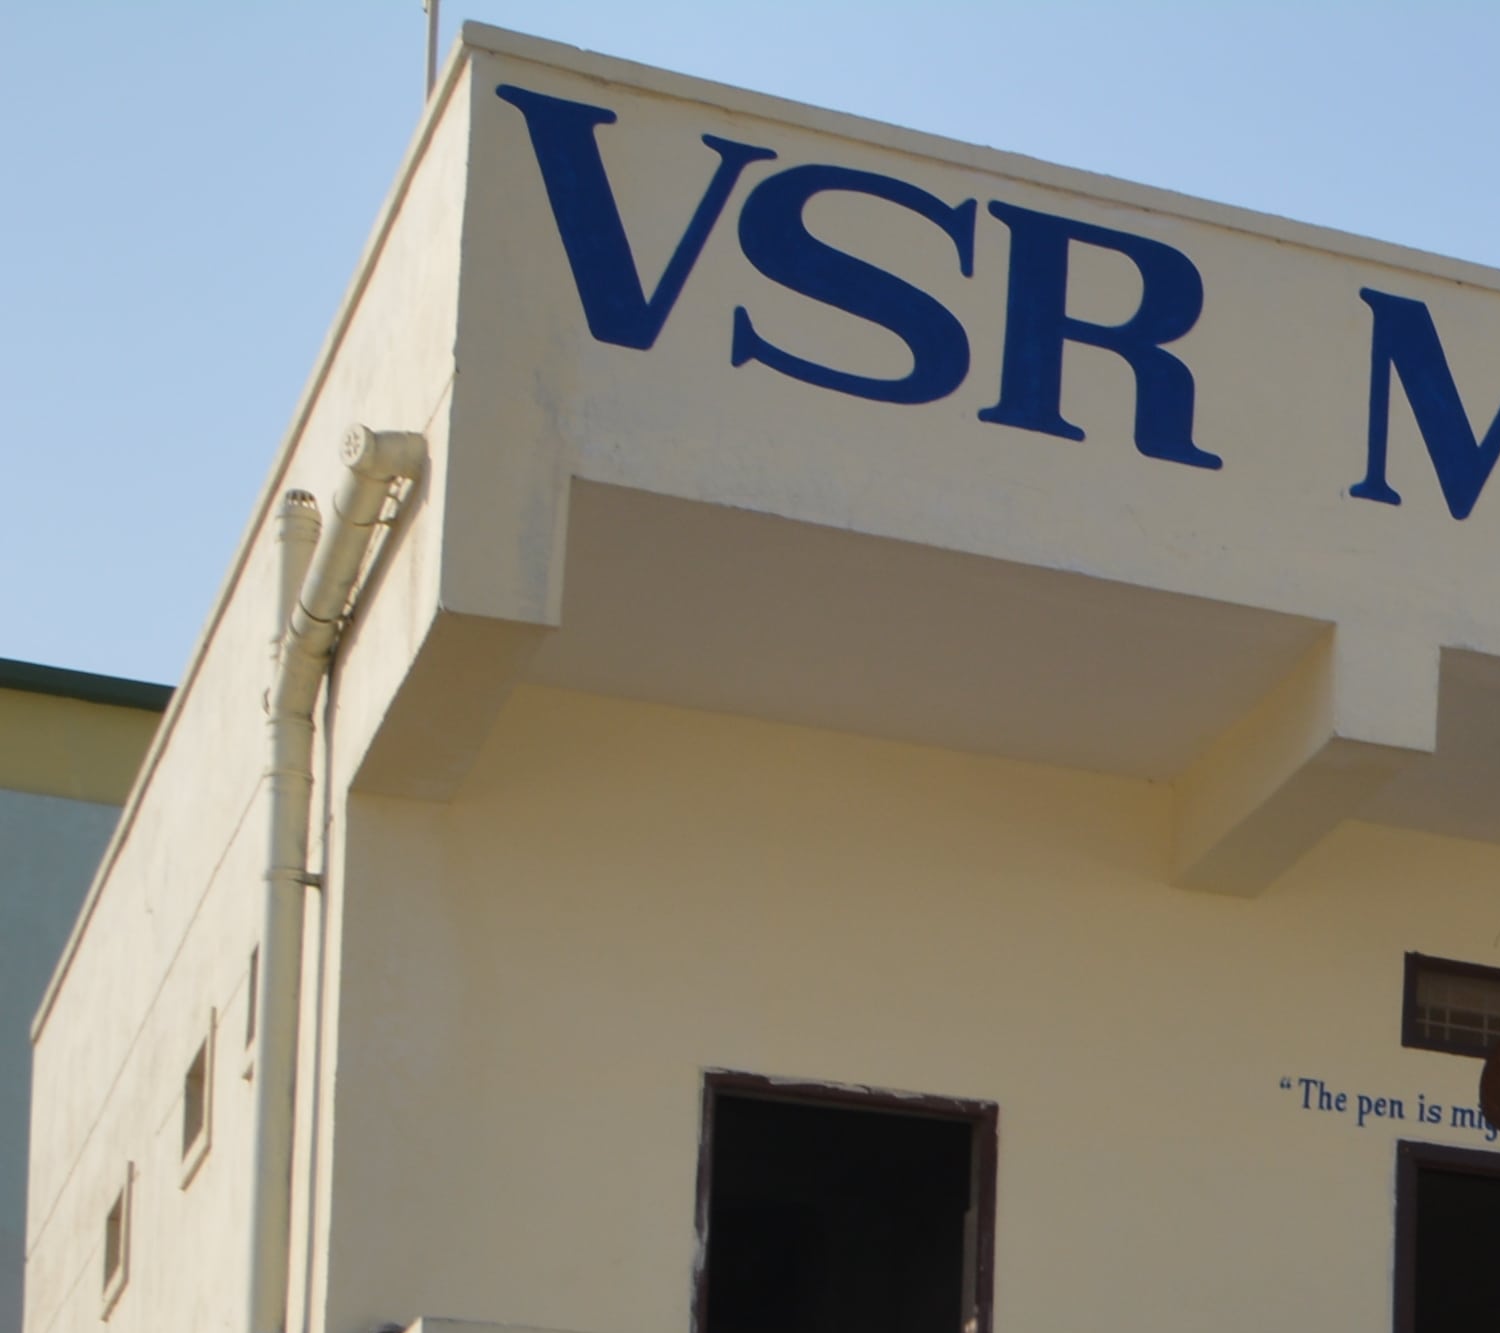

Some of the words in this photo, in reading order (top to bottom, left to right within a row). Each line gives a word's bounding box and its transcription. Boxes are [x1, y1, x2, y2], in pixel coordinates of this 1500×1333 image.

[495, 83, 1223, 471] VSR
[1356, 1092, 1405, 1127] pen
[1416, 1093, 1442, 1124] is
